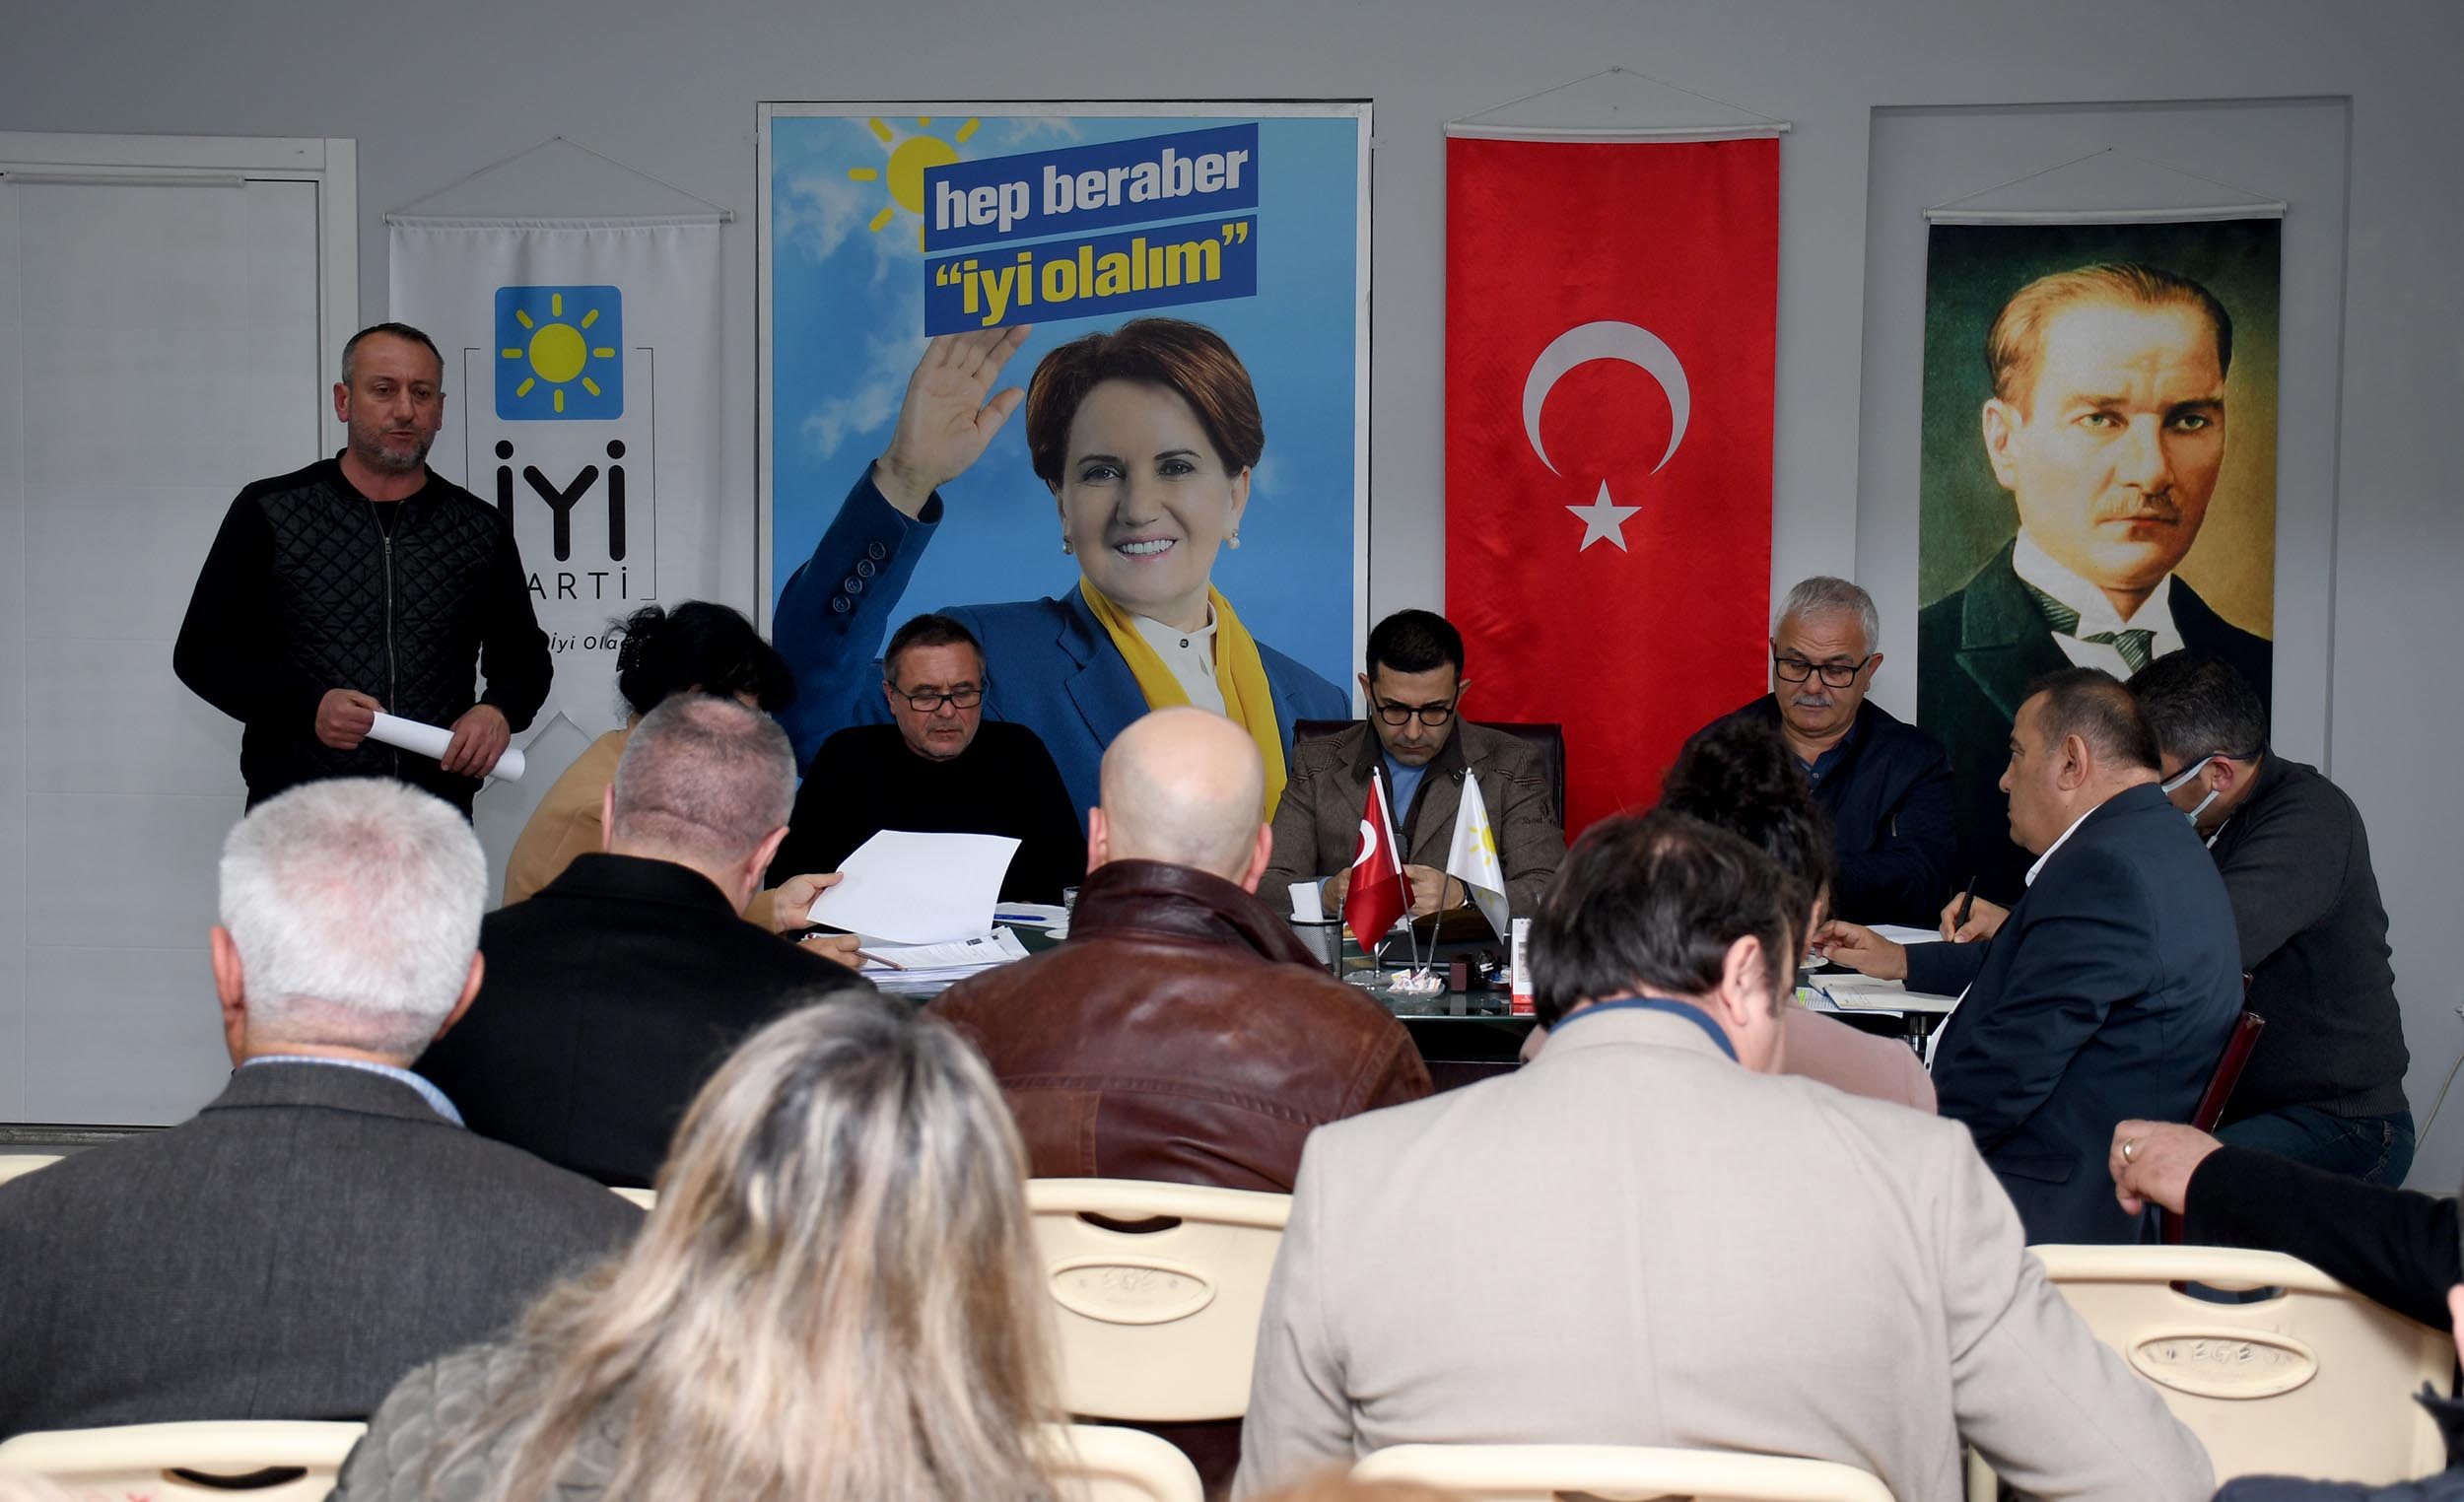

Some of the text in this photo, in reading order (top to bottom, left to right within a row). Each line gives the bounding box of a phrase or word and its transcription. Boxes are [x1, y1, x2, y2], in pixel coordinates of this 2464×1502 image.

[935, 147, 1248, 233] hep beraber
[527, 566, 627, 599] ARTİ
